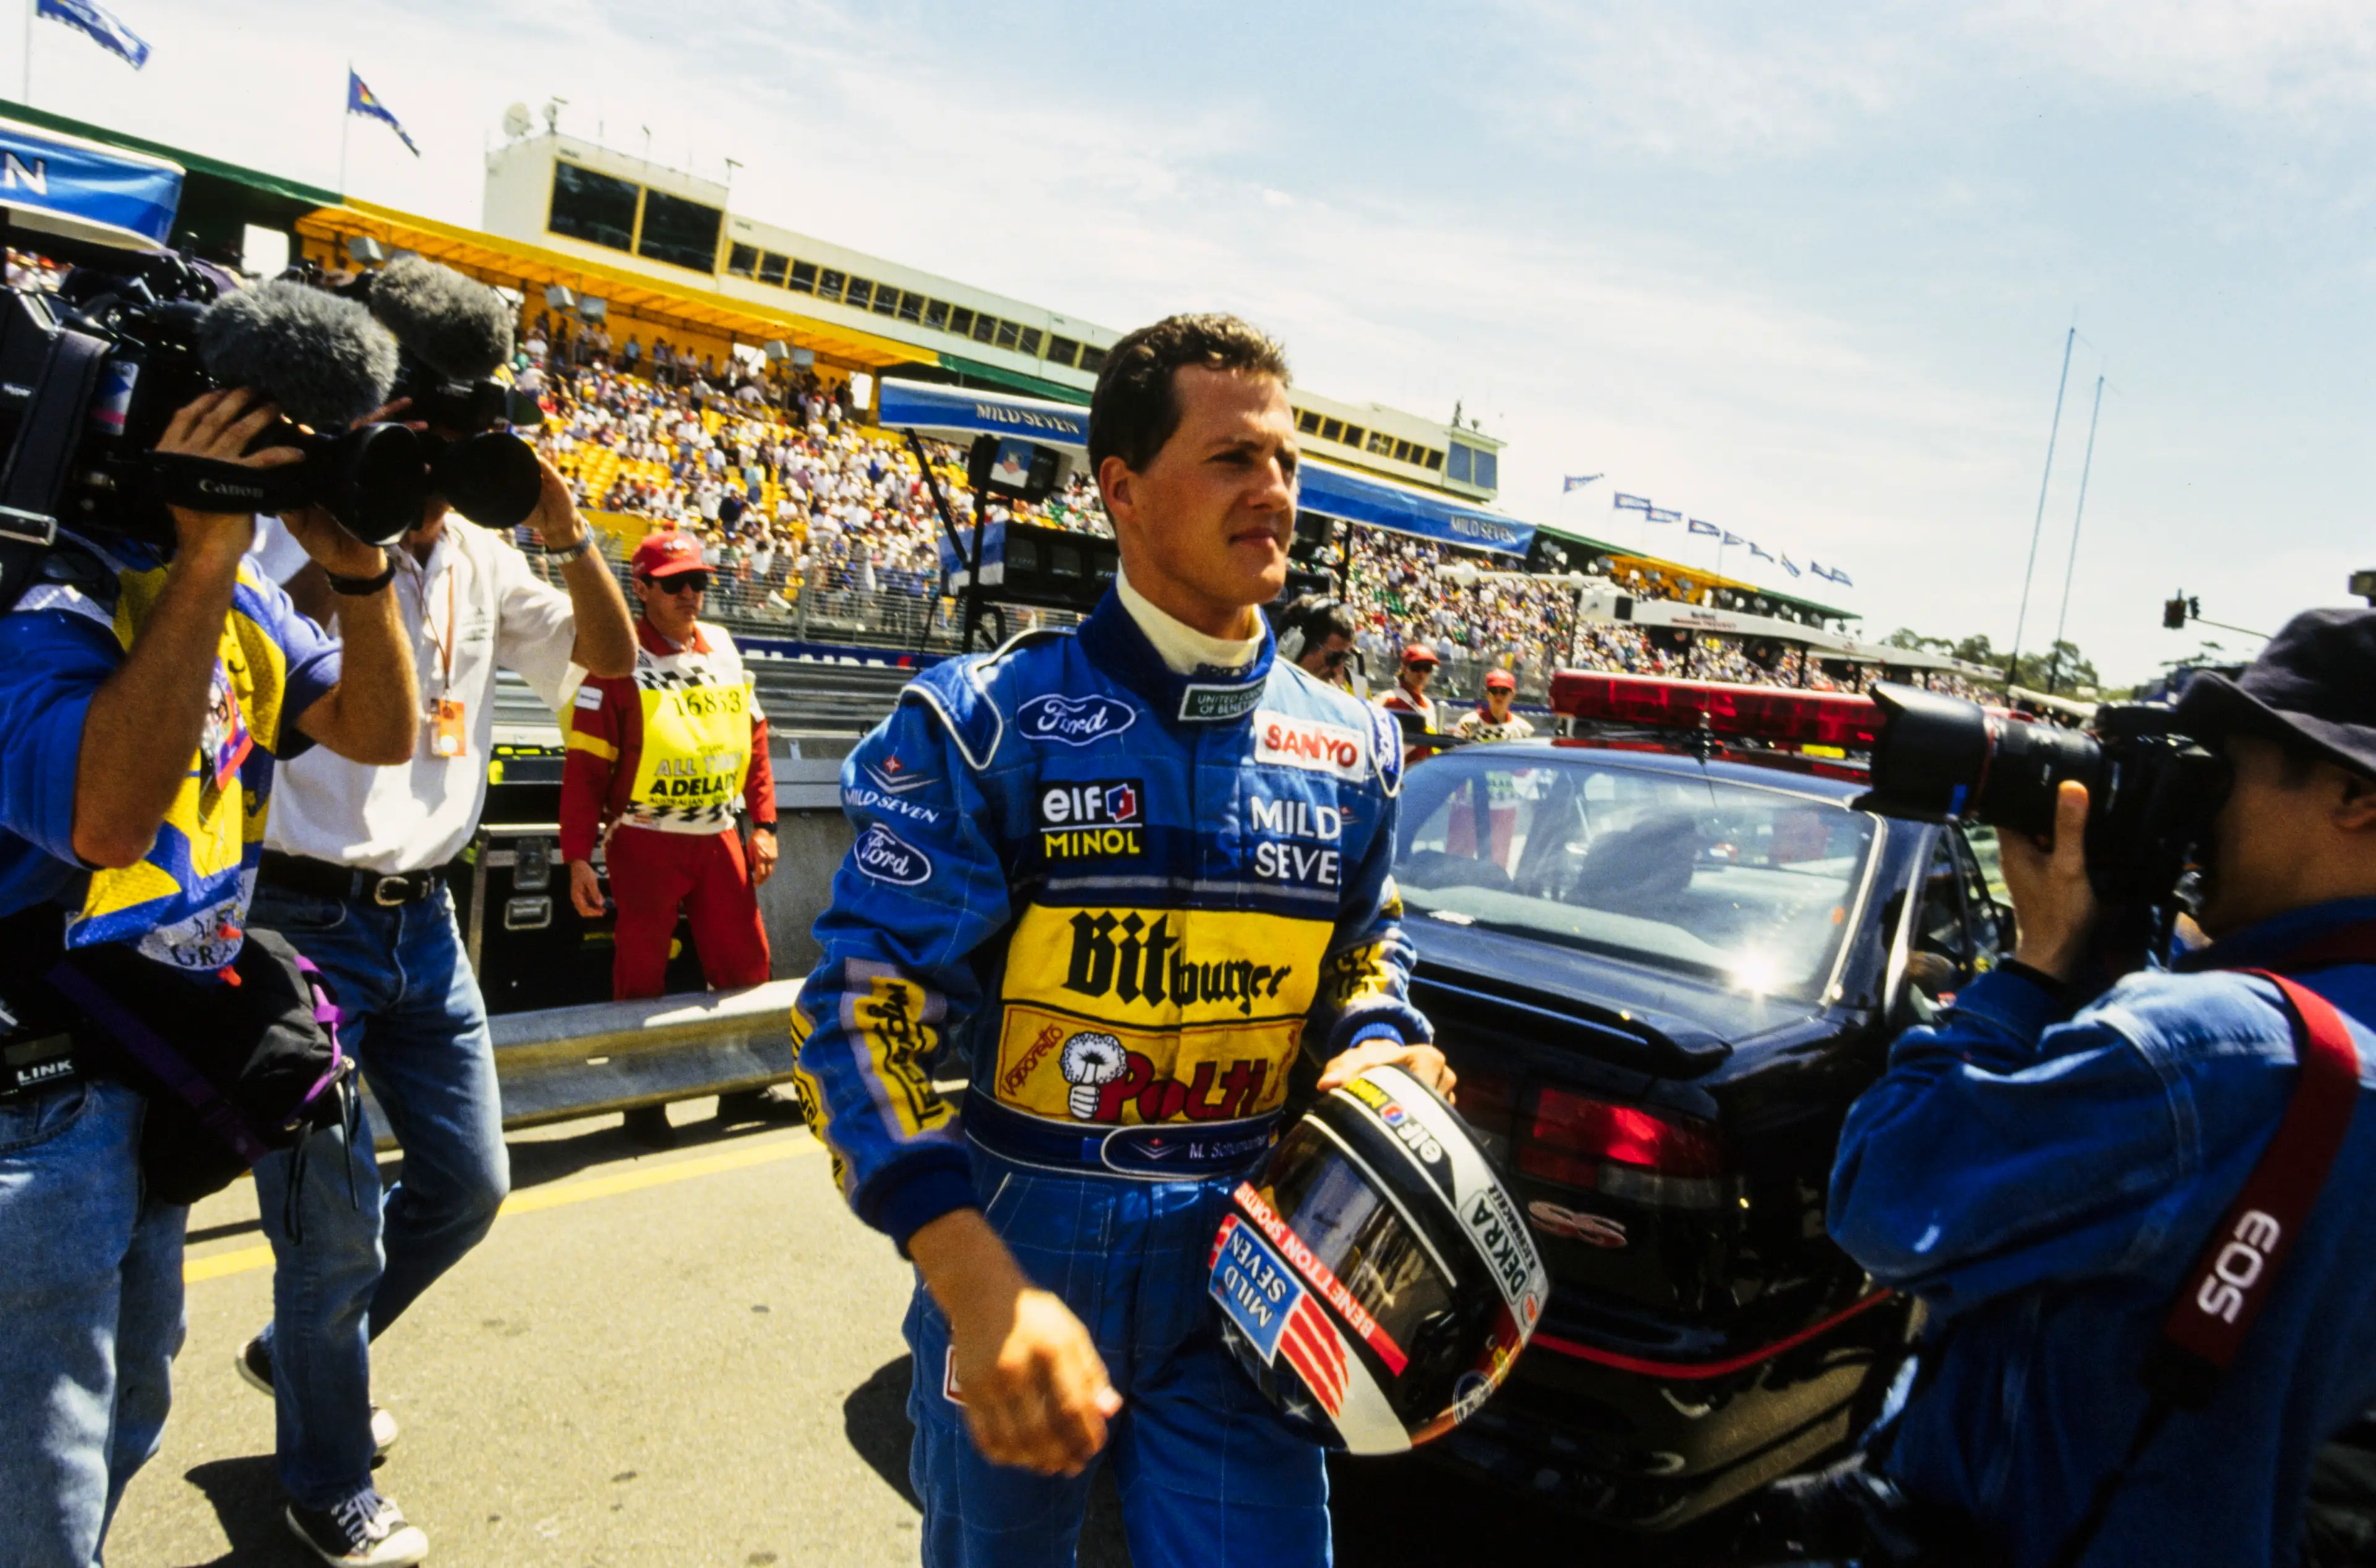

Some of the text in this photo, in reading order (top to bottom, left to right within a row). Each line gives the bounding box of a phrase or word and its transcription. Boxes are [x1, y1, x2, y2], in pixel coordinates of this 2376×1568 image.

[976, 403, 1079, 434] MILD SEVEN
[1037, 699, 1108, 734] Ford
[654, 759, 696, 777] ALL
[1265, 723, 1358, 768] SANYO
[845, 789, 940, 824] MILD SEVEN
[1043, 786, 1102, 823] elf
[1250, 795, 1342, 841] MILD
[860, 830, 910, 876] Ford
[1045, 829, 1140, 858] MINOL
[1254, 840, 1342, 885] SEVE
[1061, 910, 1292, 1016] Bitburger
[16, 1059, 72, 1083] LINK
[1397, 1122, 1442, 1164] elf
[1227, 1230, 1288, 1303] SEVEN
[1471, 1197, 1527, 1297] DEKRA
[2197, 1210, 2281, 1325] EOS
[1224, 1264, 1273, 1329] MILD
[1282, 1234, 1376, 1339] BENETTON
